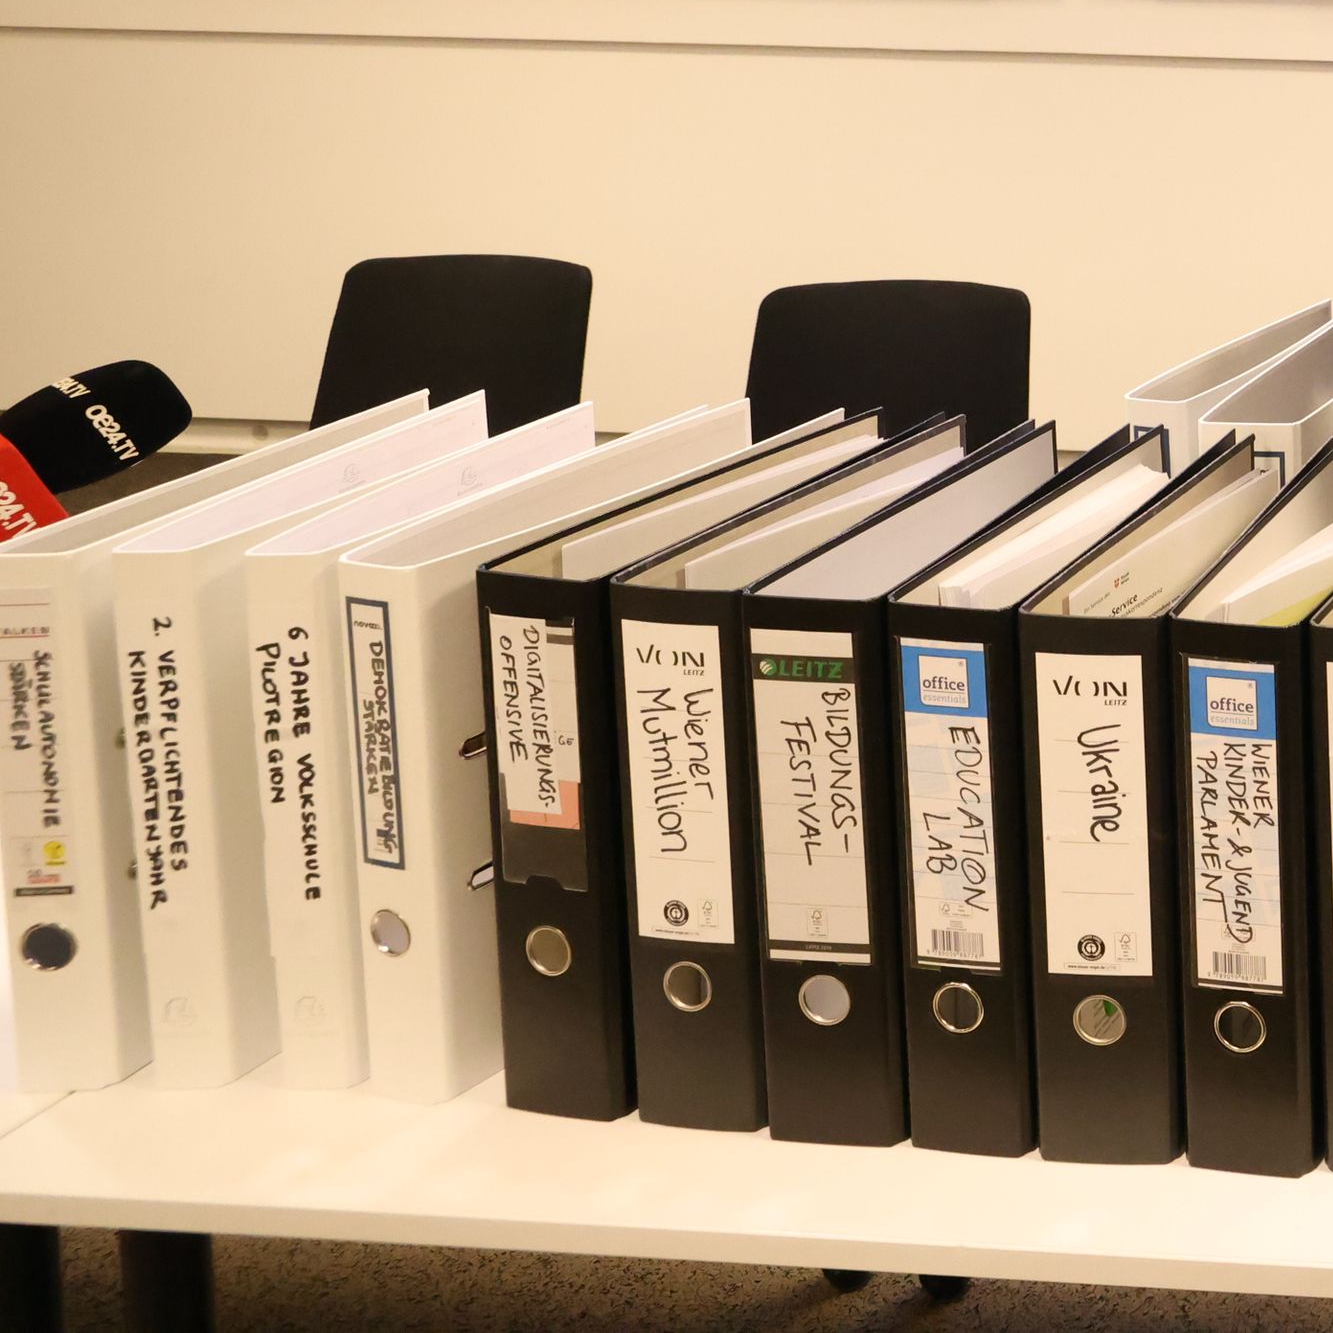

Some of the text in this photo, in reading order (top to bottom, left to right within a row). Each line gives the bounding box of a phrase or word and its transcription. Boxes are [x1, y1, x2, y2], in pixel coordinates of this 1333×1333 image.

[255, 642, 286, 804] PILOTREGION
[500, 634, 529, 762] OFFENSIVE
[779, 658, 843, 679] LEITZ
[922, 677, 966, 692] office
[922, 693, 967, 705] essentials
[1209, 698, 1254, 713] office
[1210, 714, 1255, 726] essentials
[152, 616, 190, 872] 2. VERPFLICHTENDES
[288, 626, 322, 901] 6 JAHRE VOLKSSCHULE
[637, 688, 688, 853] Mutmillion
[683, 688, 714, 800] Wiener
[780, 716, 822, 866] FESTIVAL
[822, 687, 858, 853] BILDUNGS-
[1076, 723, 1126, 843] Ukraine
[1223, 742, 1252, 839] KINDER-
[1251, 743, 1275, 829] WIENER
[923, 812, 957, 874] LAB
[948, 725, 989, 912] EDUCATION
[1196, 751, 1229, 923] PARLAMENT
[1228, 838, 1252, 856] &
[1226, 856, 1253, 943] JUGEND
